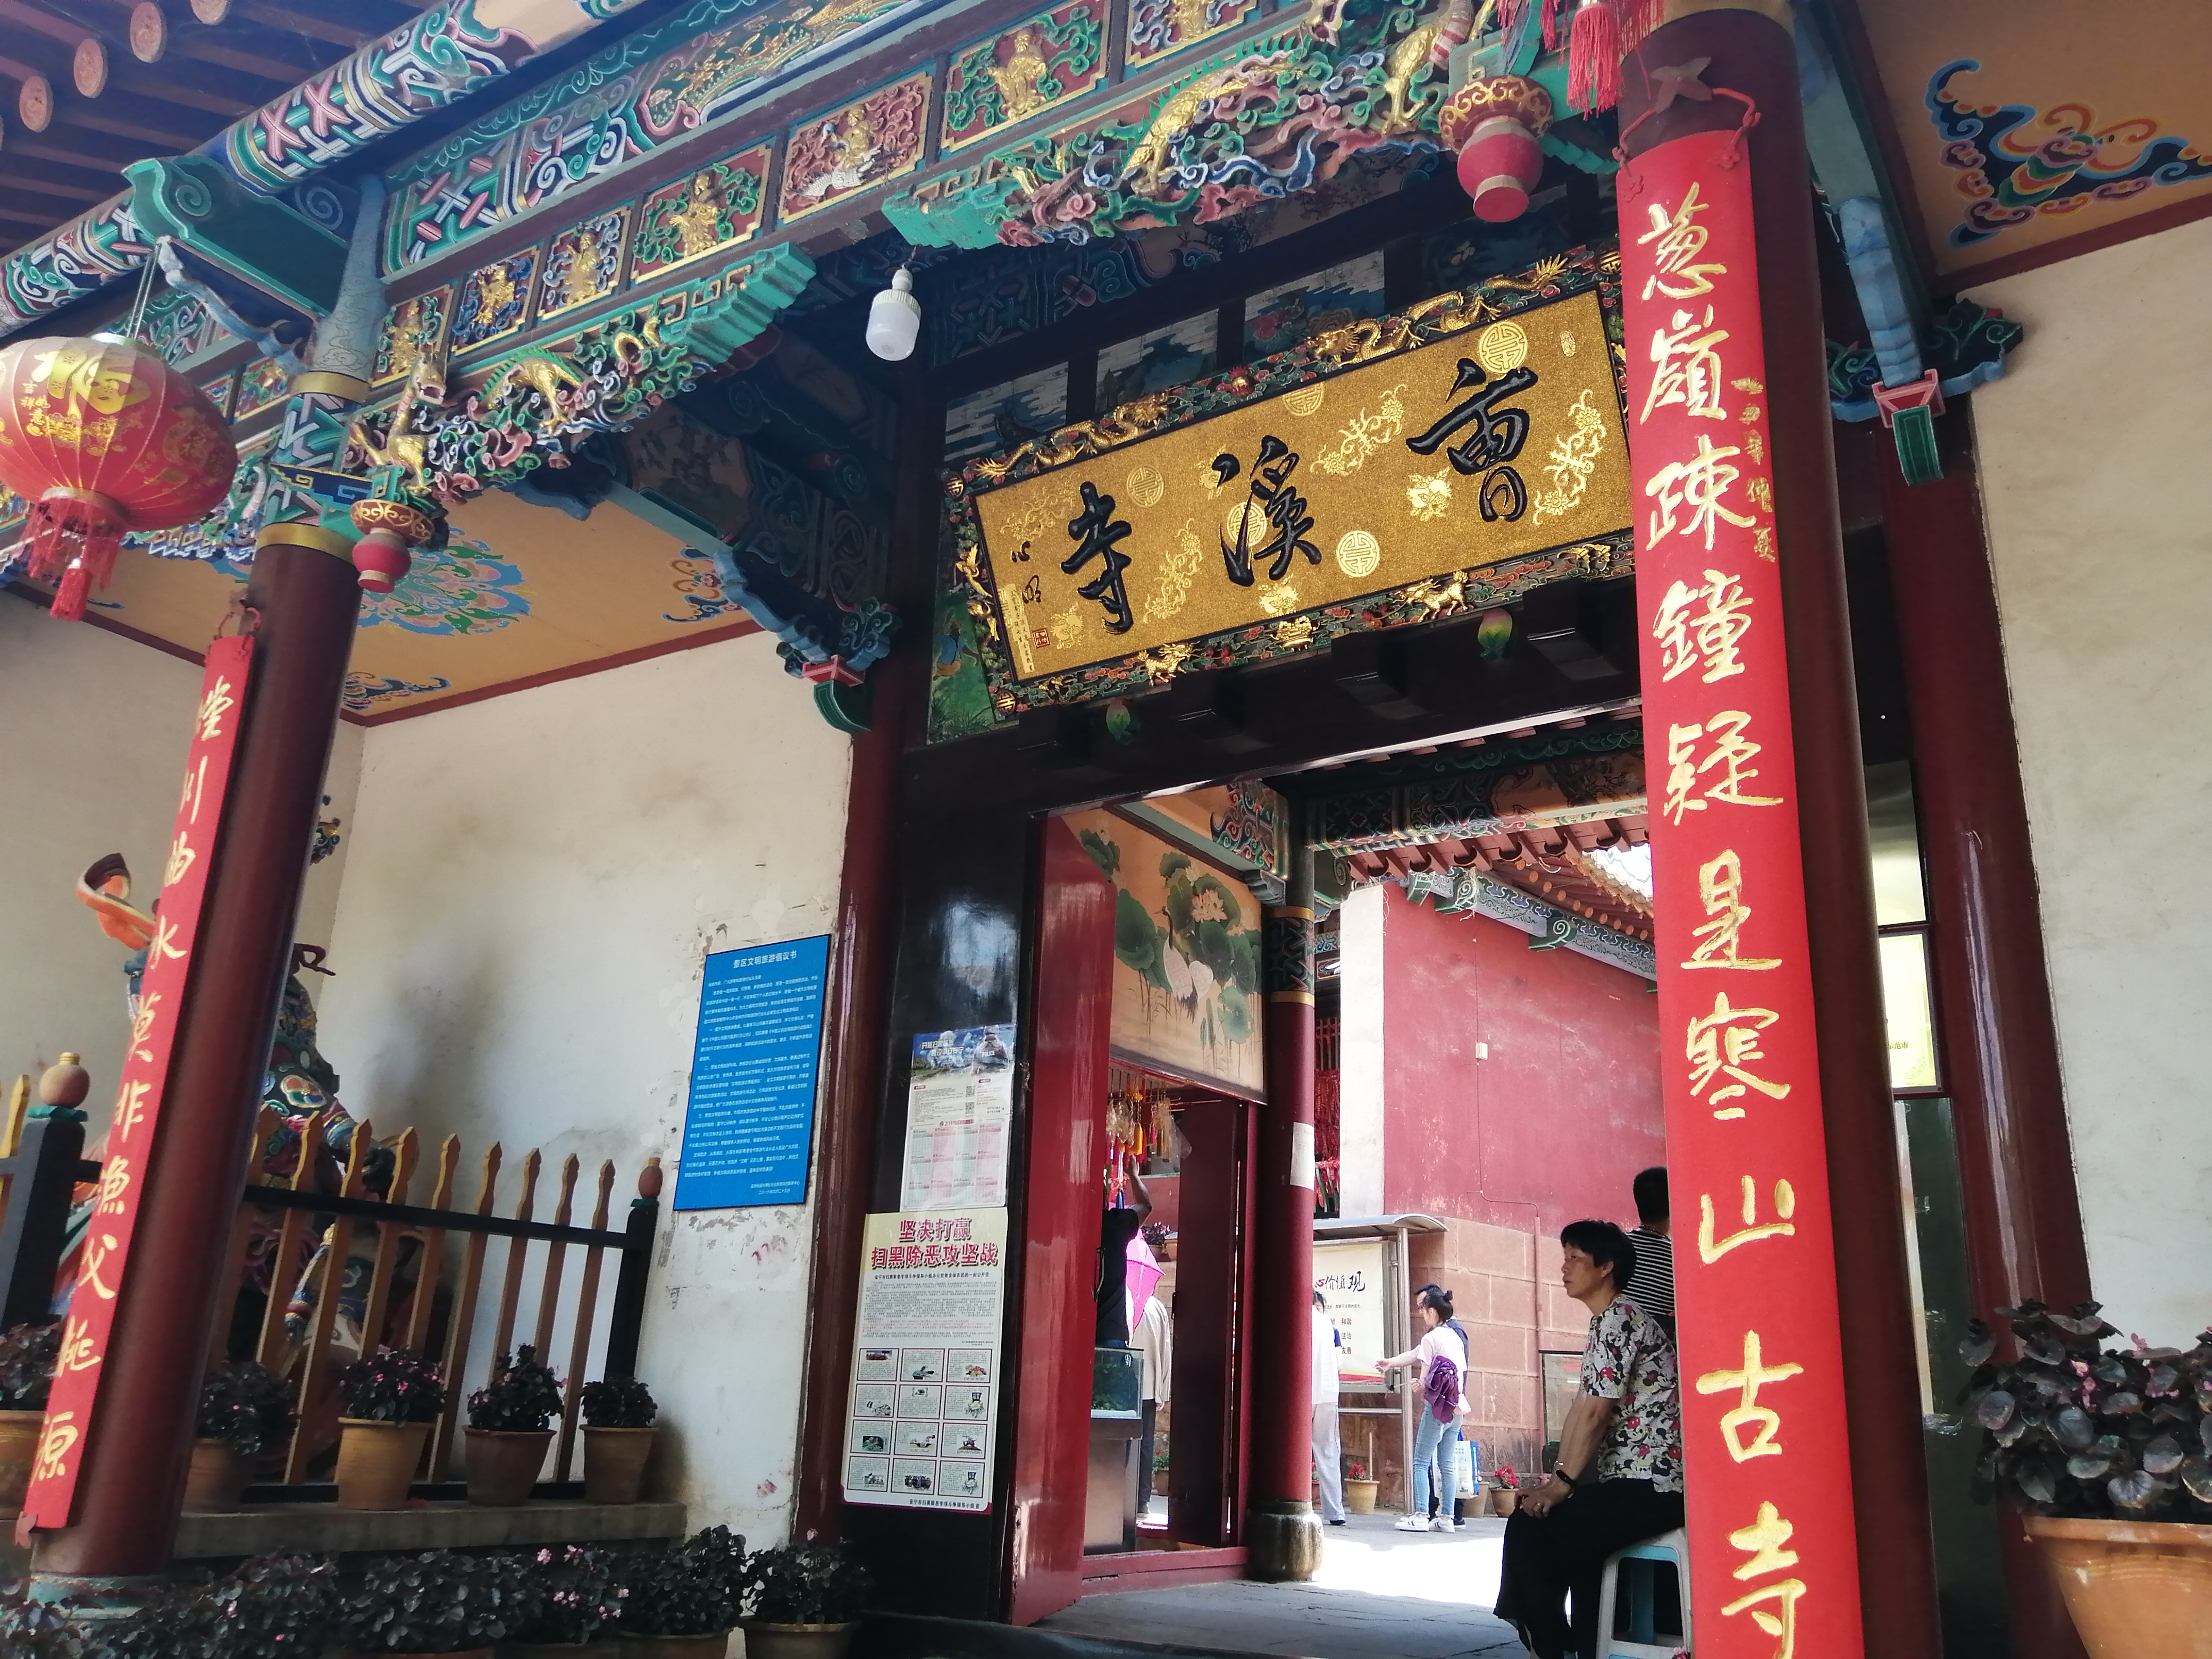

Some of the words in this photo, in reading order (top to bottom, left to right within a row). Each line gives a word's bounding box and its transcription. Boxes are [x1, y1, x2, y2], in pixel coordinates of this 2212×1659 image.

[733, 950, 797, 969] 景区文明旅游倡议书
[899, 1217, 972, 1243] 坚决打赢
[871, 1242, 999, 1269] 扫黑除恶攻坚战
